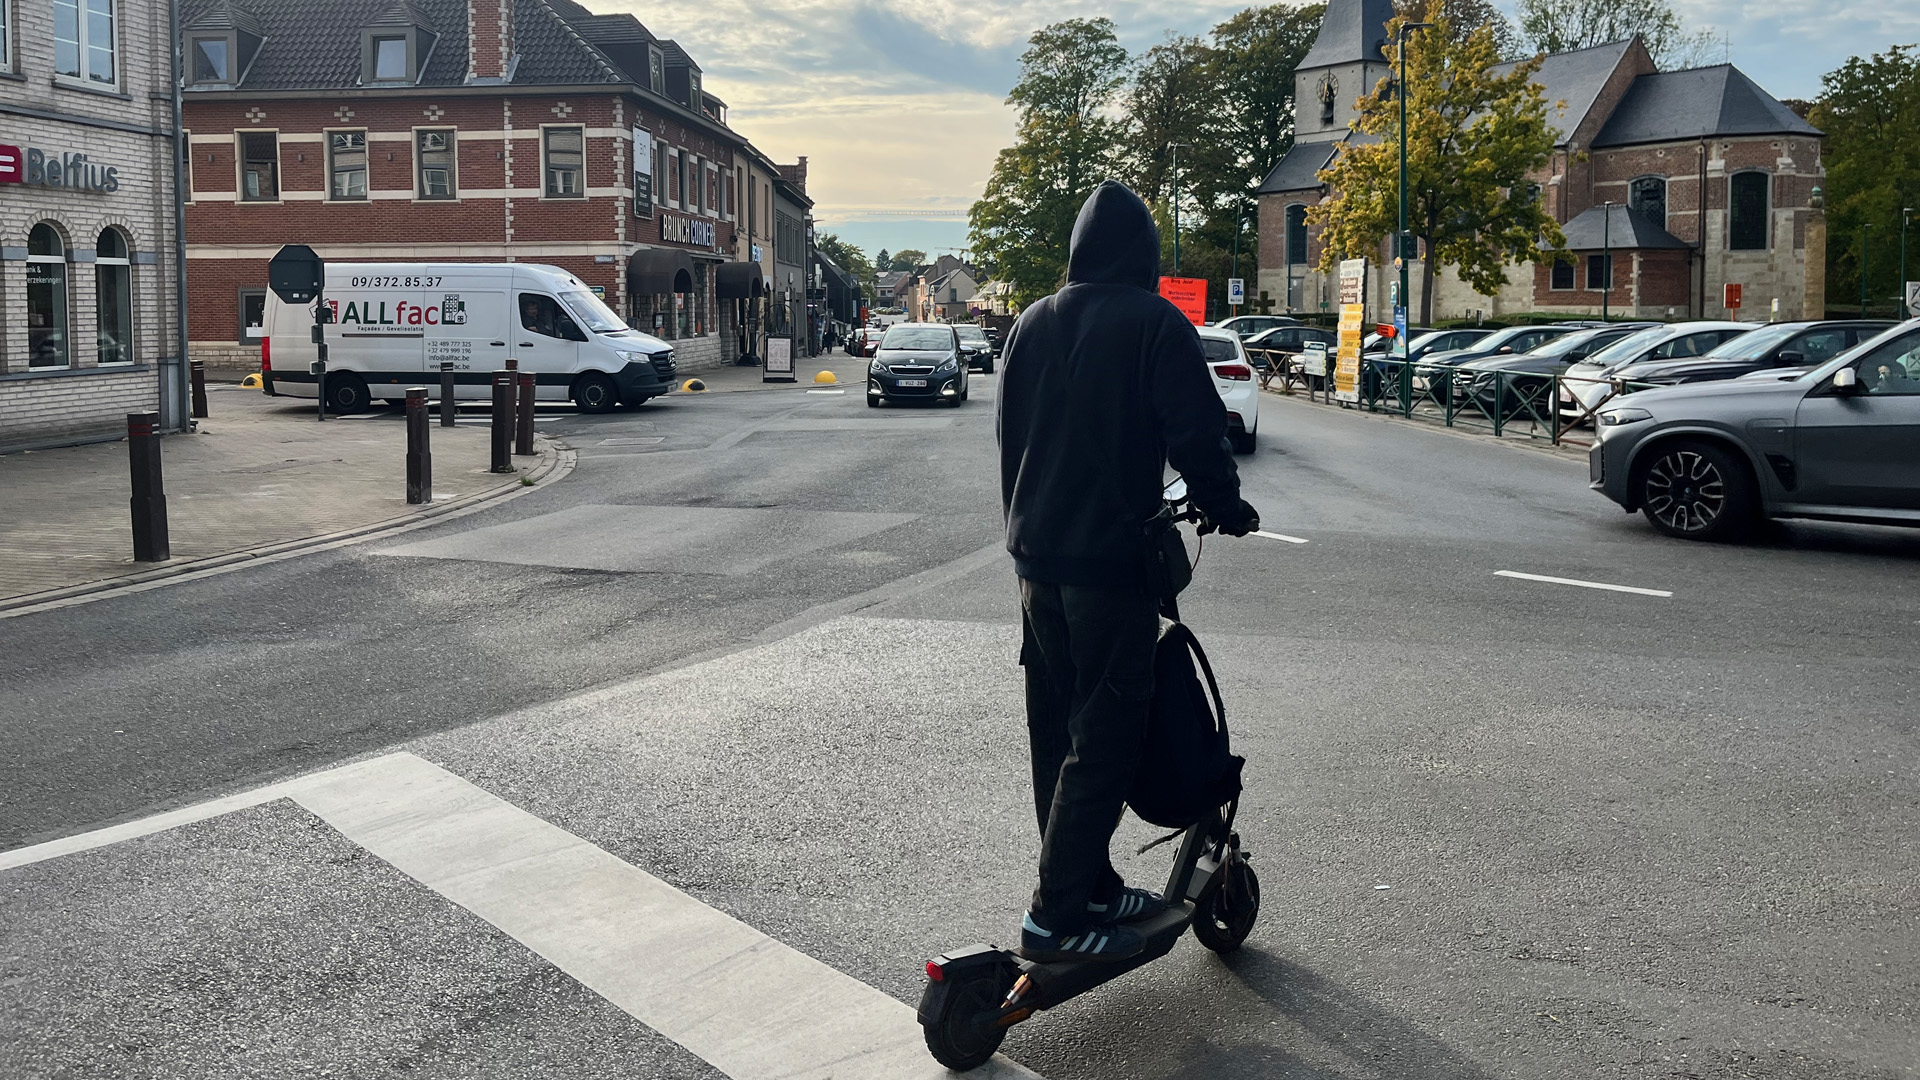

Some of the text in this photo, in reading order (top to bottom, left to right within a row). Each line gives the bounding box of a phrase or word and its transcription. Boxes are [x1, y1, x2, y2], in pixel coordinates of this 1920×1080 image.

[27, 148, 119, 192] Belfius
[663, 214, 714, 247] BRUNCH CORNER
[26, 265, 36, 273] ank
[27, 276, 62, 285] erzekeringen
[351, 276, 443, 288] 09/372.85.37
[341, 300, 439, 325] ALLfac
